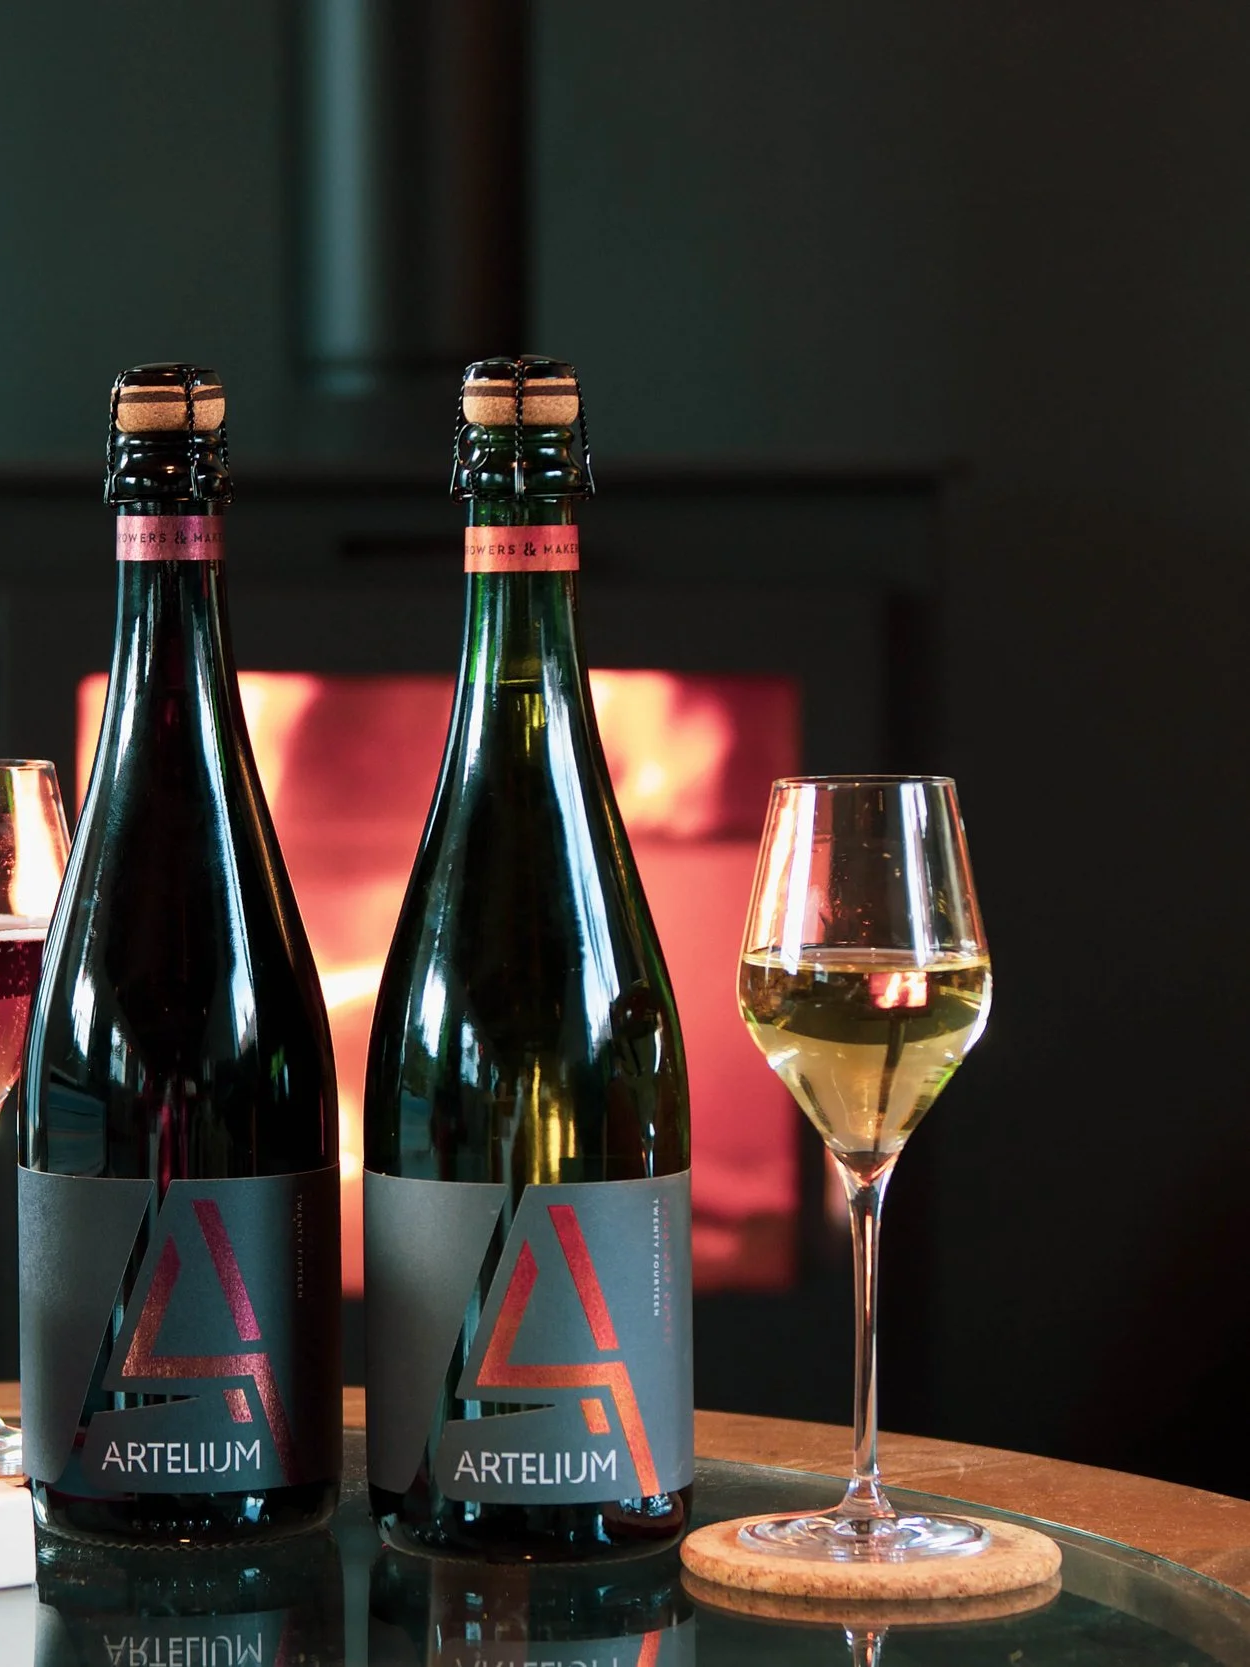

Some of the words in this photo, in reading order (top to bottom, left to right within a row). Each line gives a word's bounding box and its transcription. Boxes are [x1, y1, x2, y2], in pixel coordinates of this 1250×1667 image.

[174, 530, 187, 545] &
[523, 542, 537, 556] &
[653, 1253, 661, 1317] FOURTEEN
[101, 1439, 262, 1474] ARTELIUM
[454, 1449, 618, 1485] ARTELIUM
